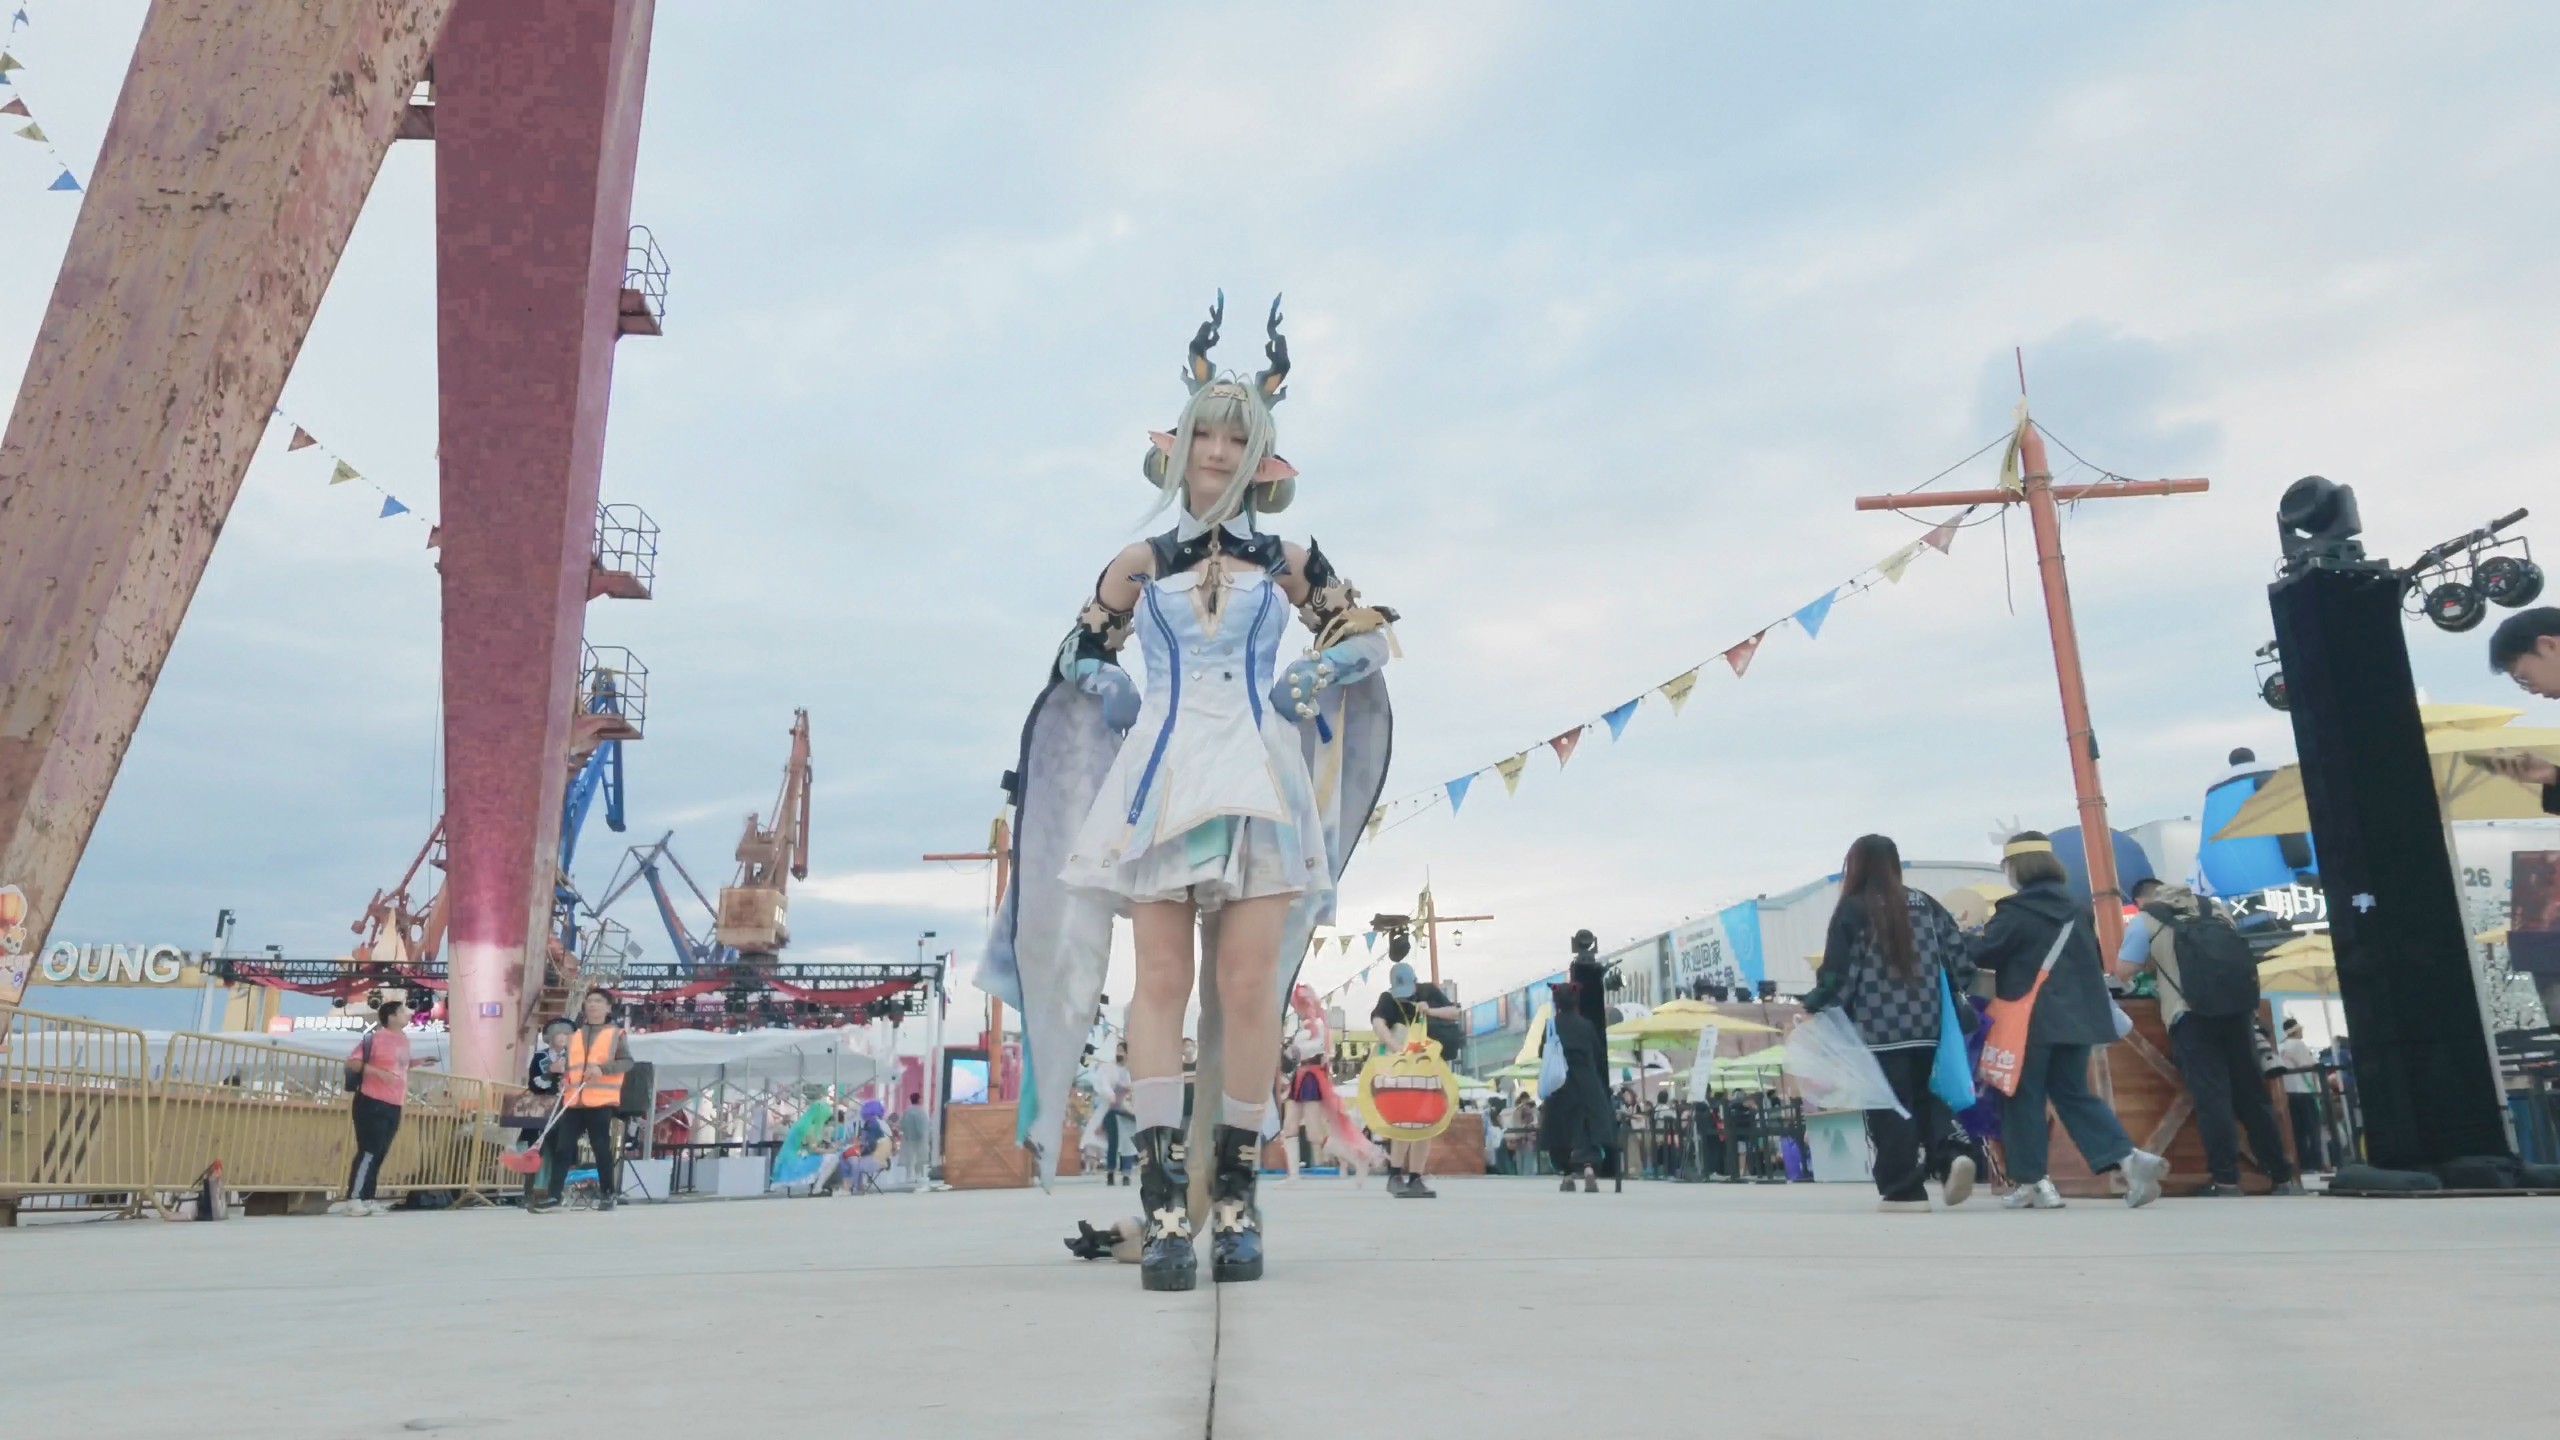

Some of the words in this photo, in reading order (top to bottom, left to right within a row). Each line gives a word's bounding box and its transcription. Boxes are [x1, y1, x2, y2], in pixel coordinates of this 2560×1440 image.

[2463, 867, 2492, 887] 26
[2256, 882, 2327, 920] 明日
[43, 941, 182, 983] OUNG
[1681, 939, 1722, 974] 欢迎回家
